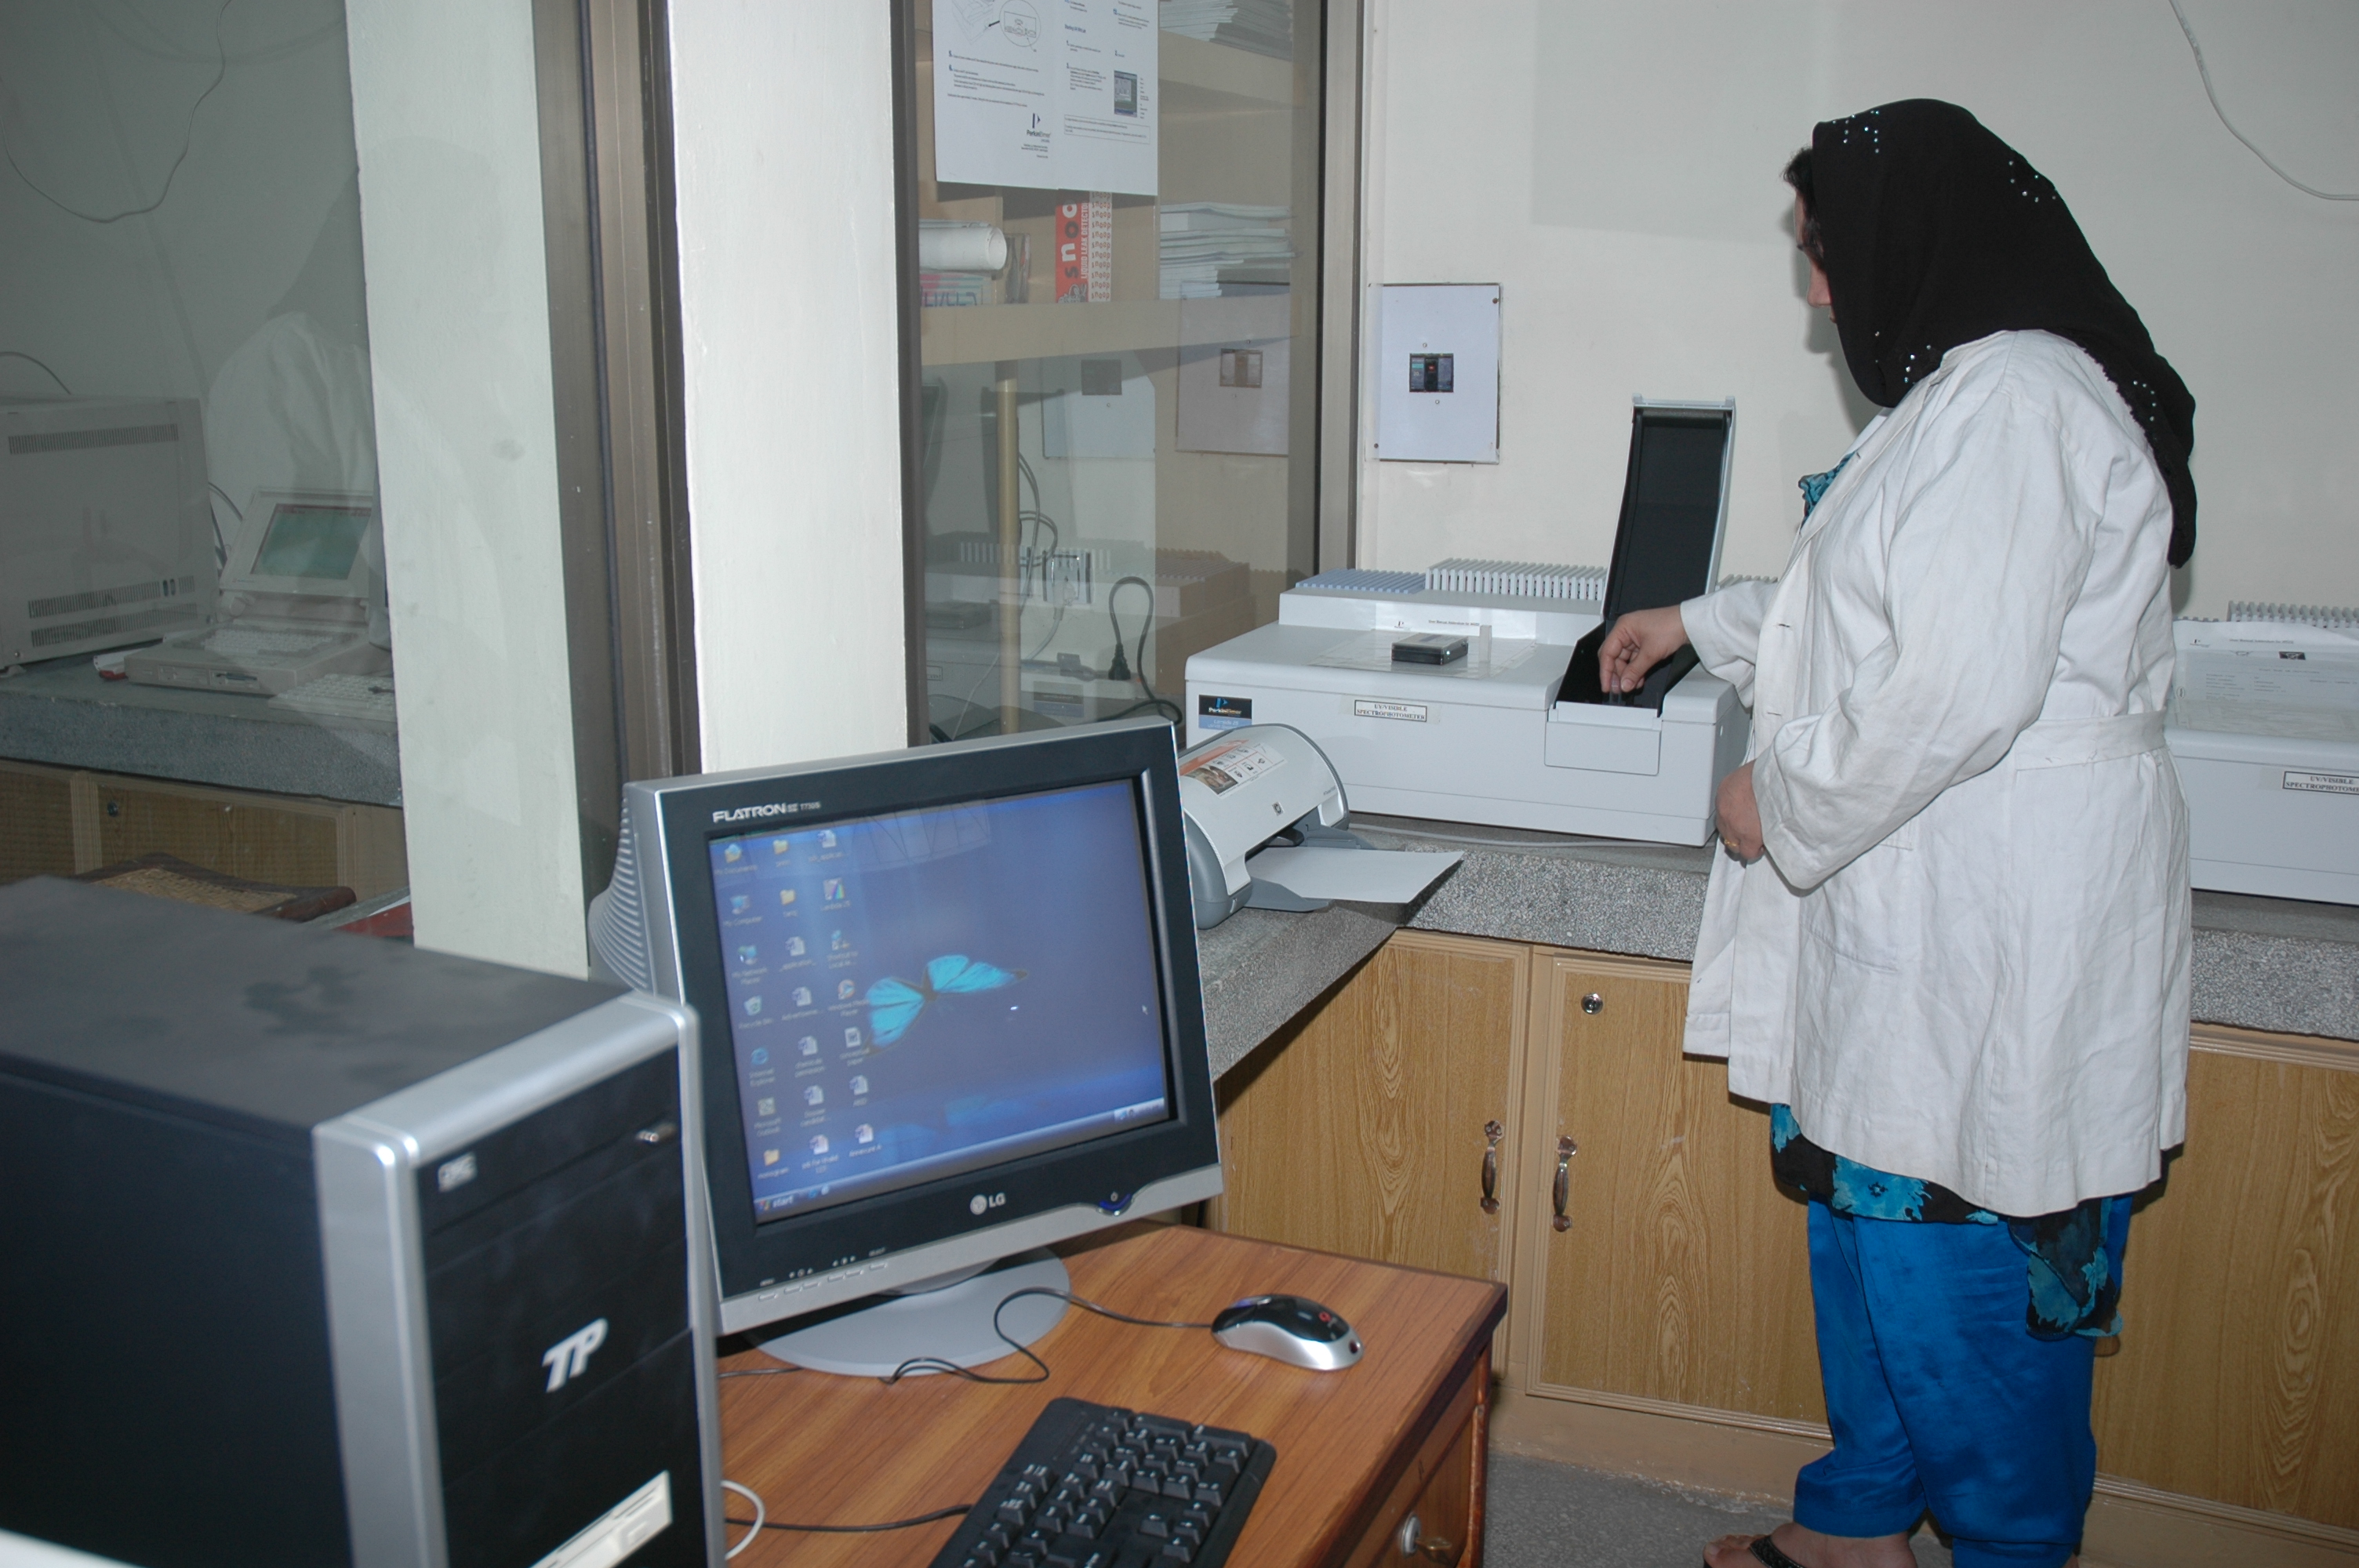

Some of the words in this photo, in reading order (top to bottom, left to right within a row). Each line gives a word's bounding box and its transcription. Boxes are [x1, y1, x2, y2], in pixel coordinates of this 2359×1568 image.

[1061, 198, 1079, 278] snoo
[1374, 703, 1408, 712] UV/VISIBLE
[1357, 710, 1425, 720] SPECTROPHOTOMETER
[2310, 775, 2354, 785] UV/VISIBLE
[712, 802, 787, 823] FLATRON
[772, 1196, 793, 1207] start
[988, 1192, 1006, 1208] LG
[541, 1317, 609, 1393] TP
